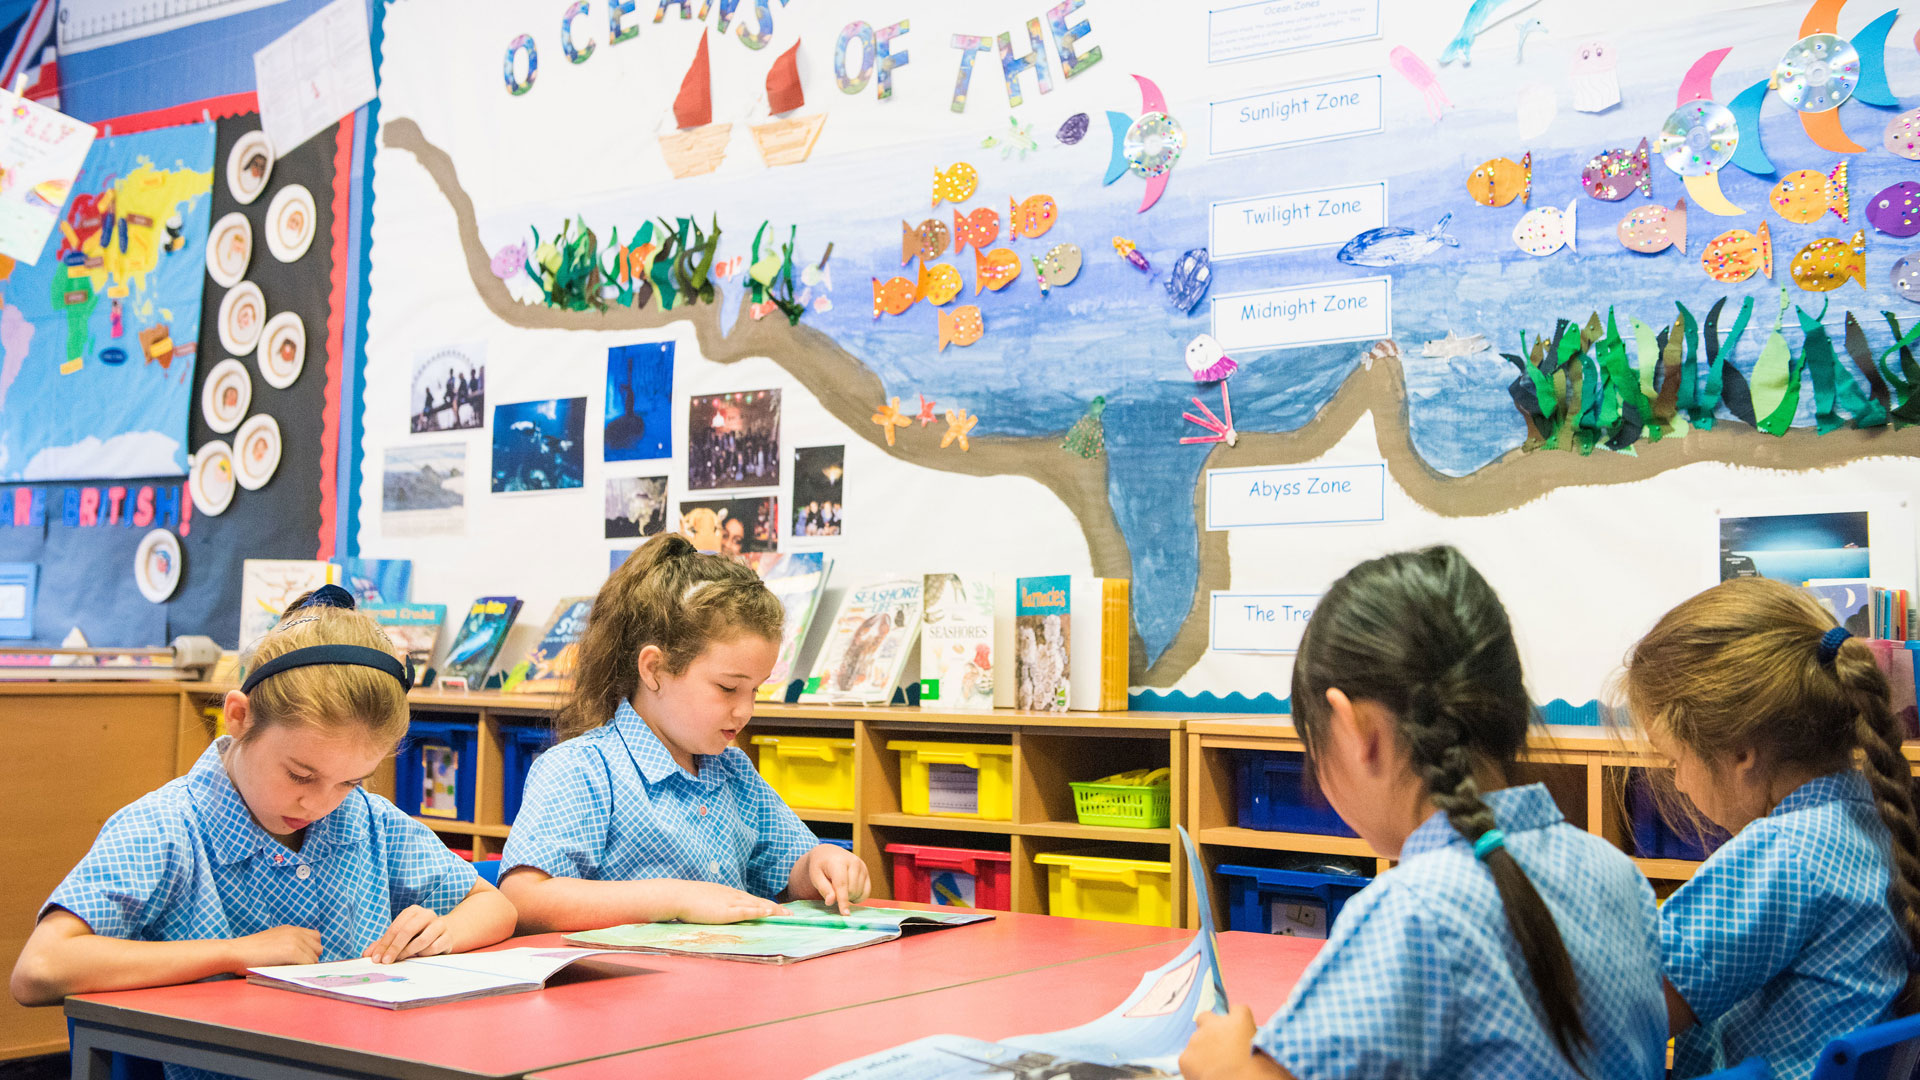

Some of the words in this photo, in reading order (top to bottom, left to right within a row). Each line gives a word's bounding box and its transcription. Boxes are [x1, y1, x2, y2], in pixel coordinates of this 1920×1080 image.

[834, 19, 910, 101] OF
[950, 0, 1104, 114] THE
[1239, 97, 1309, 123] Sunlight
[1316, 92, 1361, 111] Zone
[1243, 202, 1311, 227] Twilight
[1318, 199, 1362, 217] Zone
[1240, 297, 1317, 321] Midnight
[1323, 295, 1369, 312] Zone
[1248, 480, 1301, 502] Abyss
[1307, 477, 1352, 494] Zone
[854, 586, 920, 602] SEASHORE
[1244, 605, 1276, 622] The
[1282, 605, 1313, 622] Tre
[929, 625, 988, 639] SEASHORES
